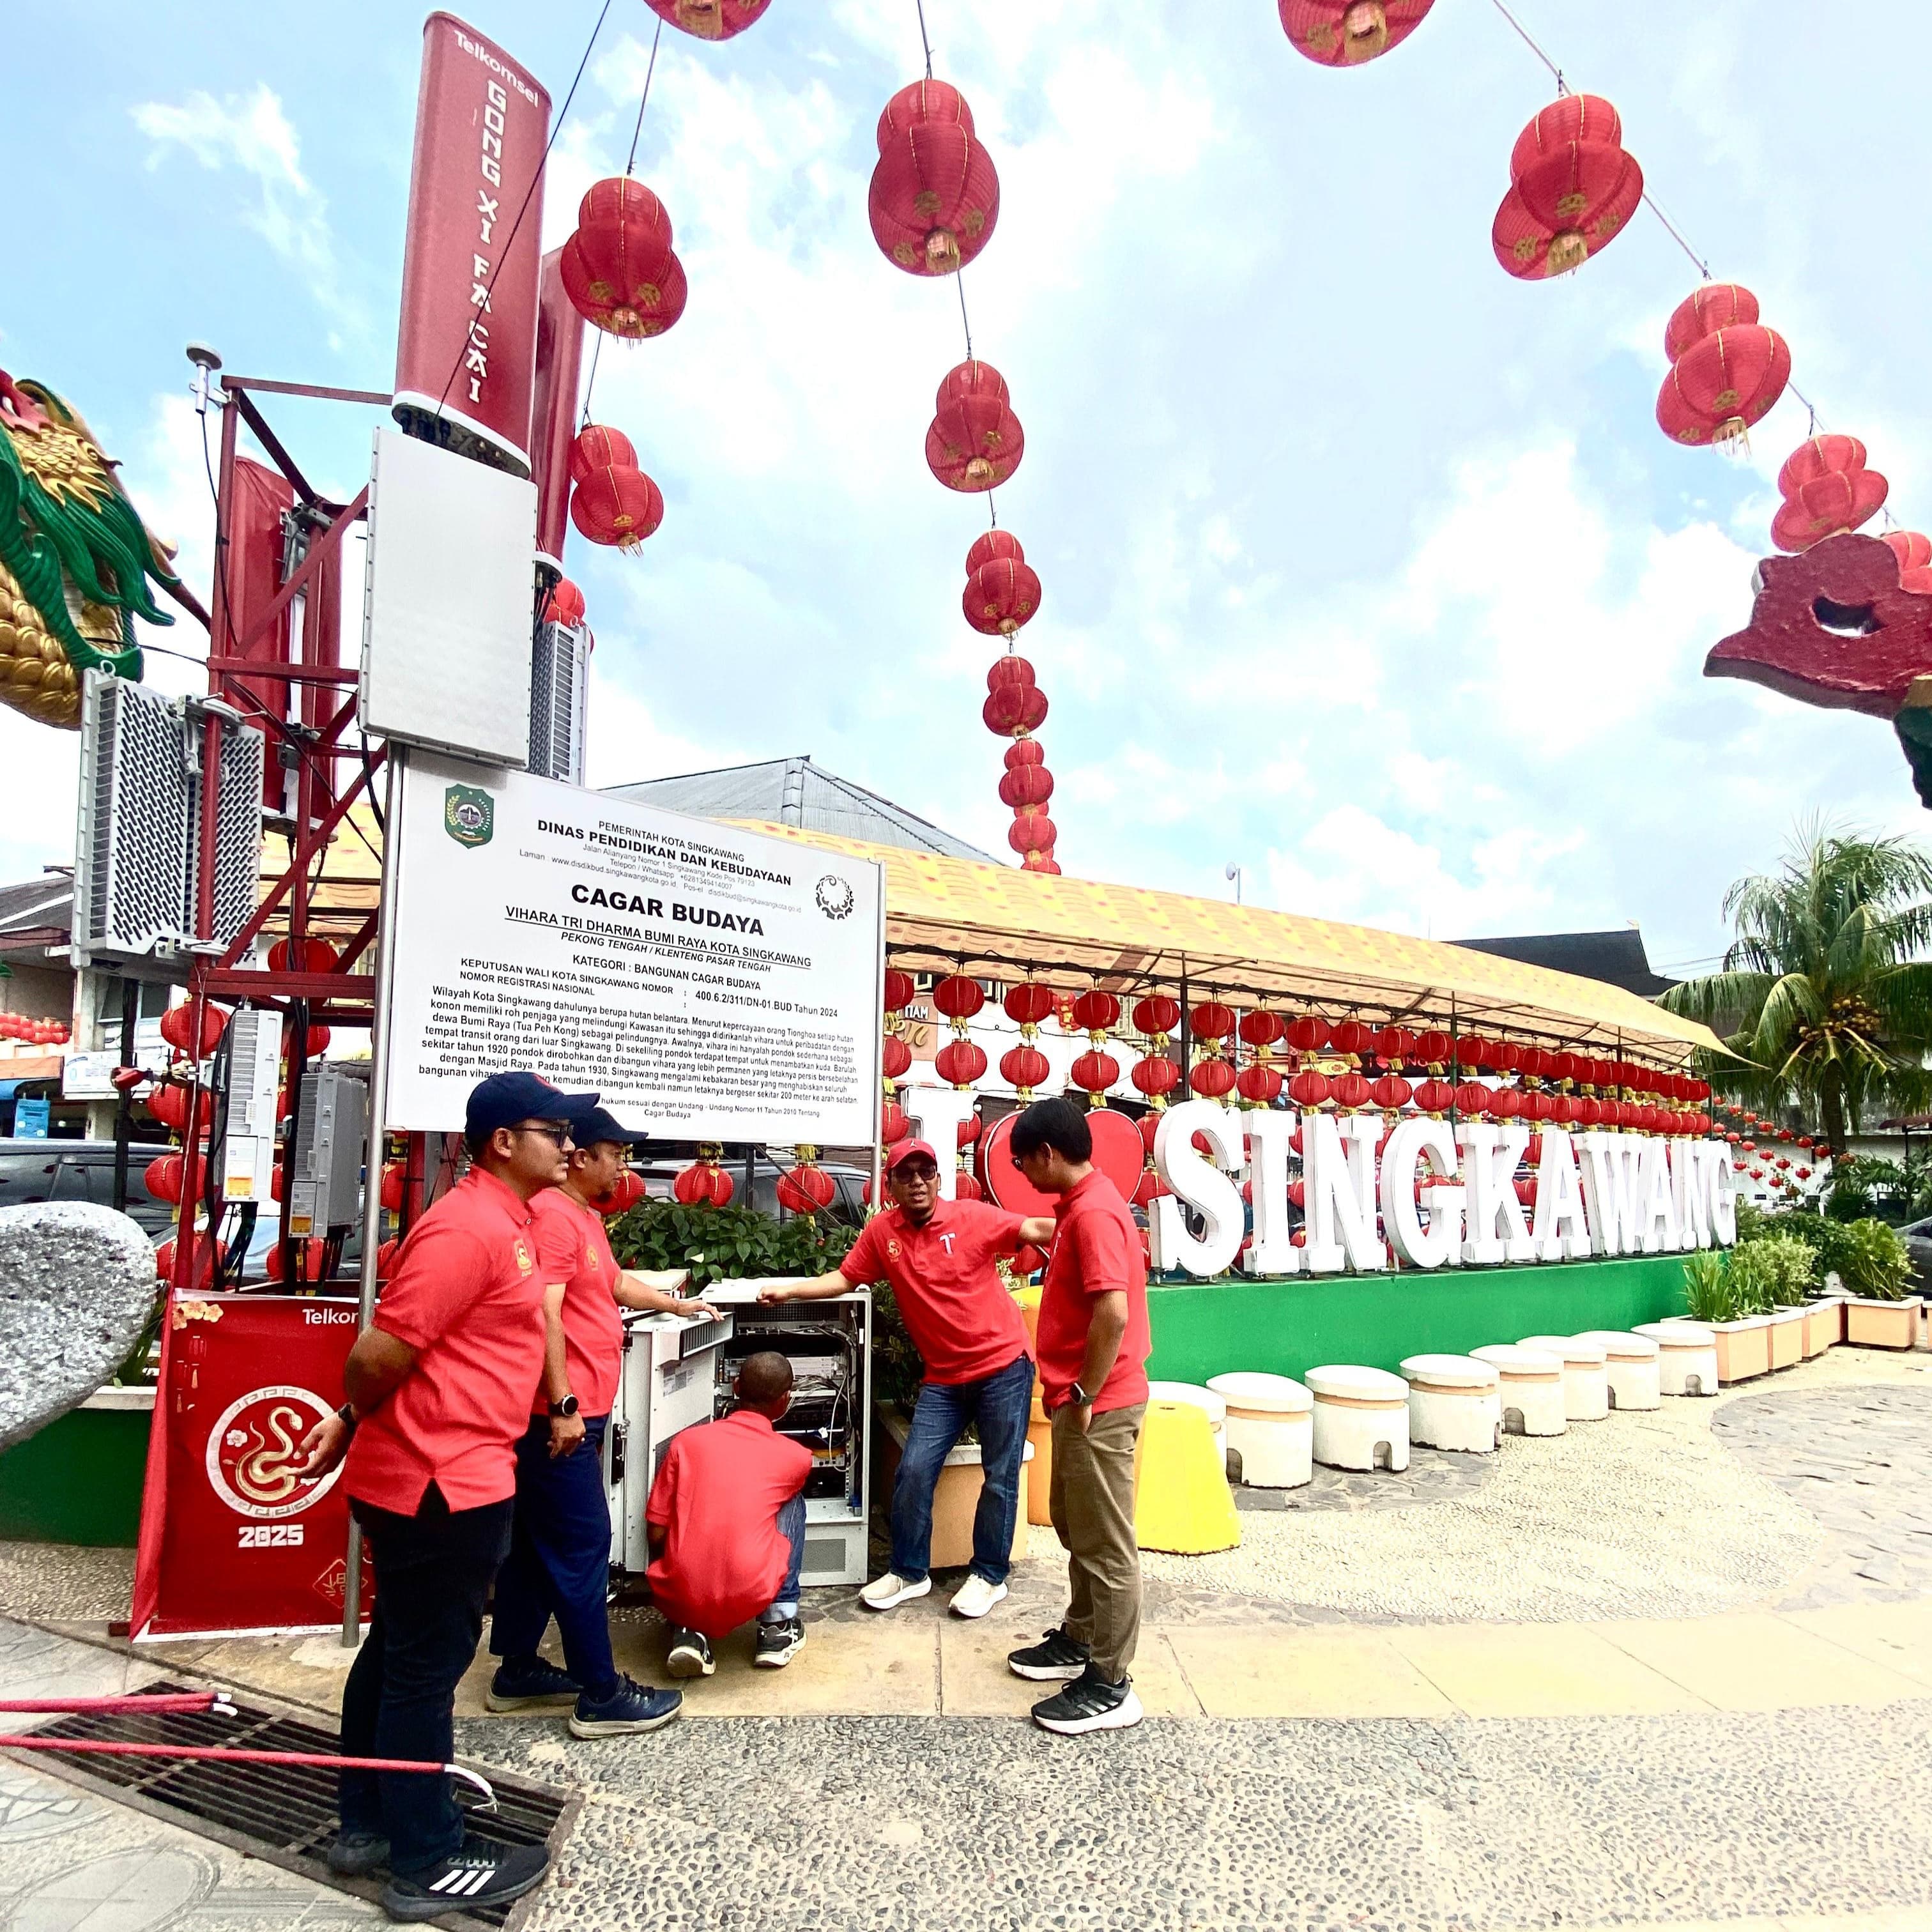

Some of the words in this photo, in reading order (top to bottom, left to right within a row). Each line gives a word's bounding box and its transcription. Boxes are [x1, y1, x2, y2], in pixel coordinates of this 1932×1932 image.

[454, 29, 539, 108] Telkomsel
[481, 79, 507, 188] GONG
[477, 190, 499, 244] XI
[470, 254, 491, 314] FA
[465, 319, 489, 404] CAI
[519, 848, 545, 860] Laman
[538, 820, 584, 839] DINAS
[589, 832, 676, 860] PENDIDIKAN
[680, 852, 707, 866] DAN
[711, 859, 791, 885] KEBUDAYAAN
[599, 821, 658, 841] PEMERINTAH
[661, 836, 685, 848] KOTA
[687, 842, 744, 862] SINGKAWANG
[571, 885, 663, 917] CAGAR
[672, 903, 764, 936] BUDAYA
[505, 906, 558, 924] VIHARA
[561, 916, 582, 928] TRI
[586, 920, 641, 939] DHARMA
[645, 930, 674, 944] BUMI
[678, 935, 707, 949] RAYA
[710, 942, 740, 954] KOTA
[742, 947, 811, 966] SINGKAWANG
[561, 932, 604, 946] PEKONG
[608, 940, 648, 953] TENGAH
[654, 947, 703, 962] KLENTENG
[705, 956, 735, 966] PASAR
[737, 960, 770, 972] TENGAH
[460, 971, 494, 983] NOMOR
[497, 976, 551, 990] REGISTRASI
[552, 983, 595, 995] NASIONAL
[461, 958, 523, 974] KEPUTUSAN
[525, 967, 549, 977] WALI
[552, 971, 577, 981] KOTA
[579, 975, 639, 989] SINGKAWANG
[641, 983, 673, 993] NOMOR
[794, 1004, 818, 1015] Tahun
[820, 1008, 838, 1017] 2024
[572, 954, 625, 970] KATEGORI
[634, 964, 689, 980] BANGUNAN
[691, 972, 724, 985] CAGAR
[726, 977, 761, 990] BUDAYA
[431, 999, 461, 1011] konon
[463, 1005, 502, 1015] memiliki
[523, 1011, 556, 1022] penjaga
[559, 1015, 579, 1025] yang
[582, 1018, 627, 1031] melindungi
[629, 1022, 664, 1032] Kawasan
[677, 1027, 710, 1039] sehingga
[433, 986, 470, 999] Wilayah
[473, 991, 494, 1001] Kota
[497, 993, 551, 1010] Singkawang
[553, 1001, 597, 1015] dahulunya
[599, 1006, 627, 1018] berupa
[629, 1010, 651, 1019] hutan
[692, 1017, 721, 1027] Menurut
[723, 1021, 765, 1033] kepercayaan
[767, 1028, 785, 1037] orang
[425, 1026, 458, 1038] tempat
[461, 1029, 491, 1039] transit
[493, 1034, 520, 1045] orang
[523, 1035, 539, 1044] dari
[542, 1037, 558, 1046] luar
[616, 1043, 624, 1052] Di
[626, 1046, 663, 1057] sekeliling
[694, 1052, 723, 1062] terdapat
[725, 1055, 748, 1064] tempat
[433, 1013, 457, 1023] dewa
[461, 1015, 484, 1026] Bumi
[487, 1018, 510, 1031] Raya
[513, 1021, 532, 1031] (Tua
[534, 1023, 551, 1032] Peh
[553, 1025, 579, 1038] Kong)
[581, 1029, 613, 1040] sebagai
[706, 1042, 728, 1050] vihara
[740, 1045, 769, 1055] hanyalah
[422, 1039, 455, 1049] sekitar
[457, 1042, 484, 1052] tahun
[487, 1044, 508, 1054] 1920
[510, 1048, 544, 1057] pondok
[546, 1050, 594, 1061] dirobohkan
[597, 1054, 611, 1062] dan
[613, 1055, 650, 1068] dibangun
[652, 1059, 675, 1068] vihara
[677, 1063, 695, 1072] yang
[752, 1070, 768, 1078] yang
[770, 1070, 796, 1080] letaknya
[440, 1054, 475, 1066] dengan
[478, 1056, 507, 1068] Masjid
[538, 1061, 559, 1071] Pada
[562, 1064, 585, 1072] tahun
[611, 1067, 658, 1080] Singkawang
[661, 1073, 700, 1082] mengalami
[703, 1075, 739, 1084] kebakaran
[760, 1081, 776, 1089] yang
[418, 1065, 467, 1077] bangunan
[553, 1075, 593, 1085] kemudian
[595, 1078, 633, 1089] dibangun
[636, 1081, 665, 1090] kembali
[694, 1085, 723, 1096] letaknya
[726, 1087, 755, 1098] bergeser
[644, 1109, 664, 1117] Cagar
[666, 1110, 691, 1119] Budaya
[652, 1101, 676, 1109] dengan
[678, 1102, 703, 1111] Undang
[709, 1104, 733, 1113] Undang
[901, 1085, 975, 1202] I
[1148, 1099, 1736, 1277] SINGKAWANG
[238, 1524, 303, 1547] 2025
